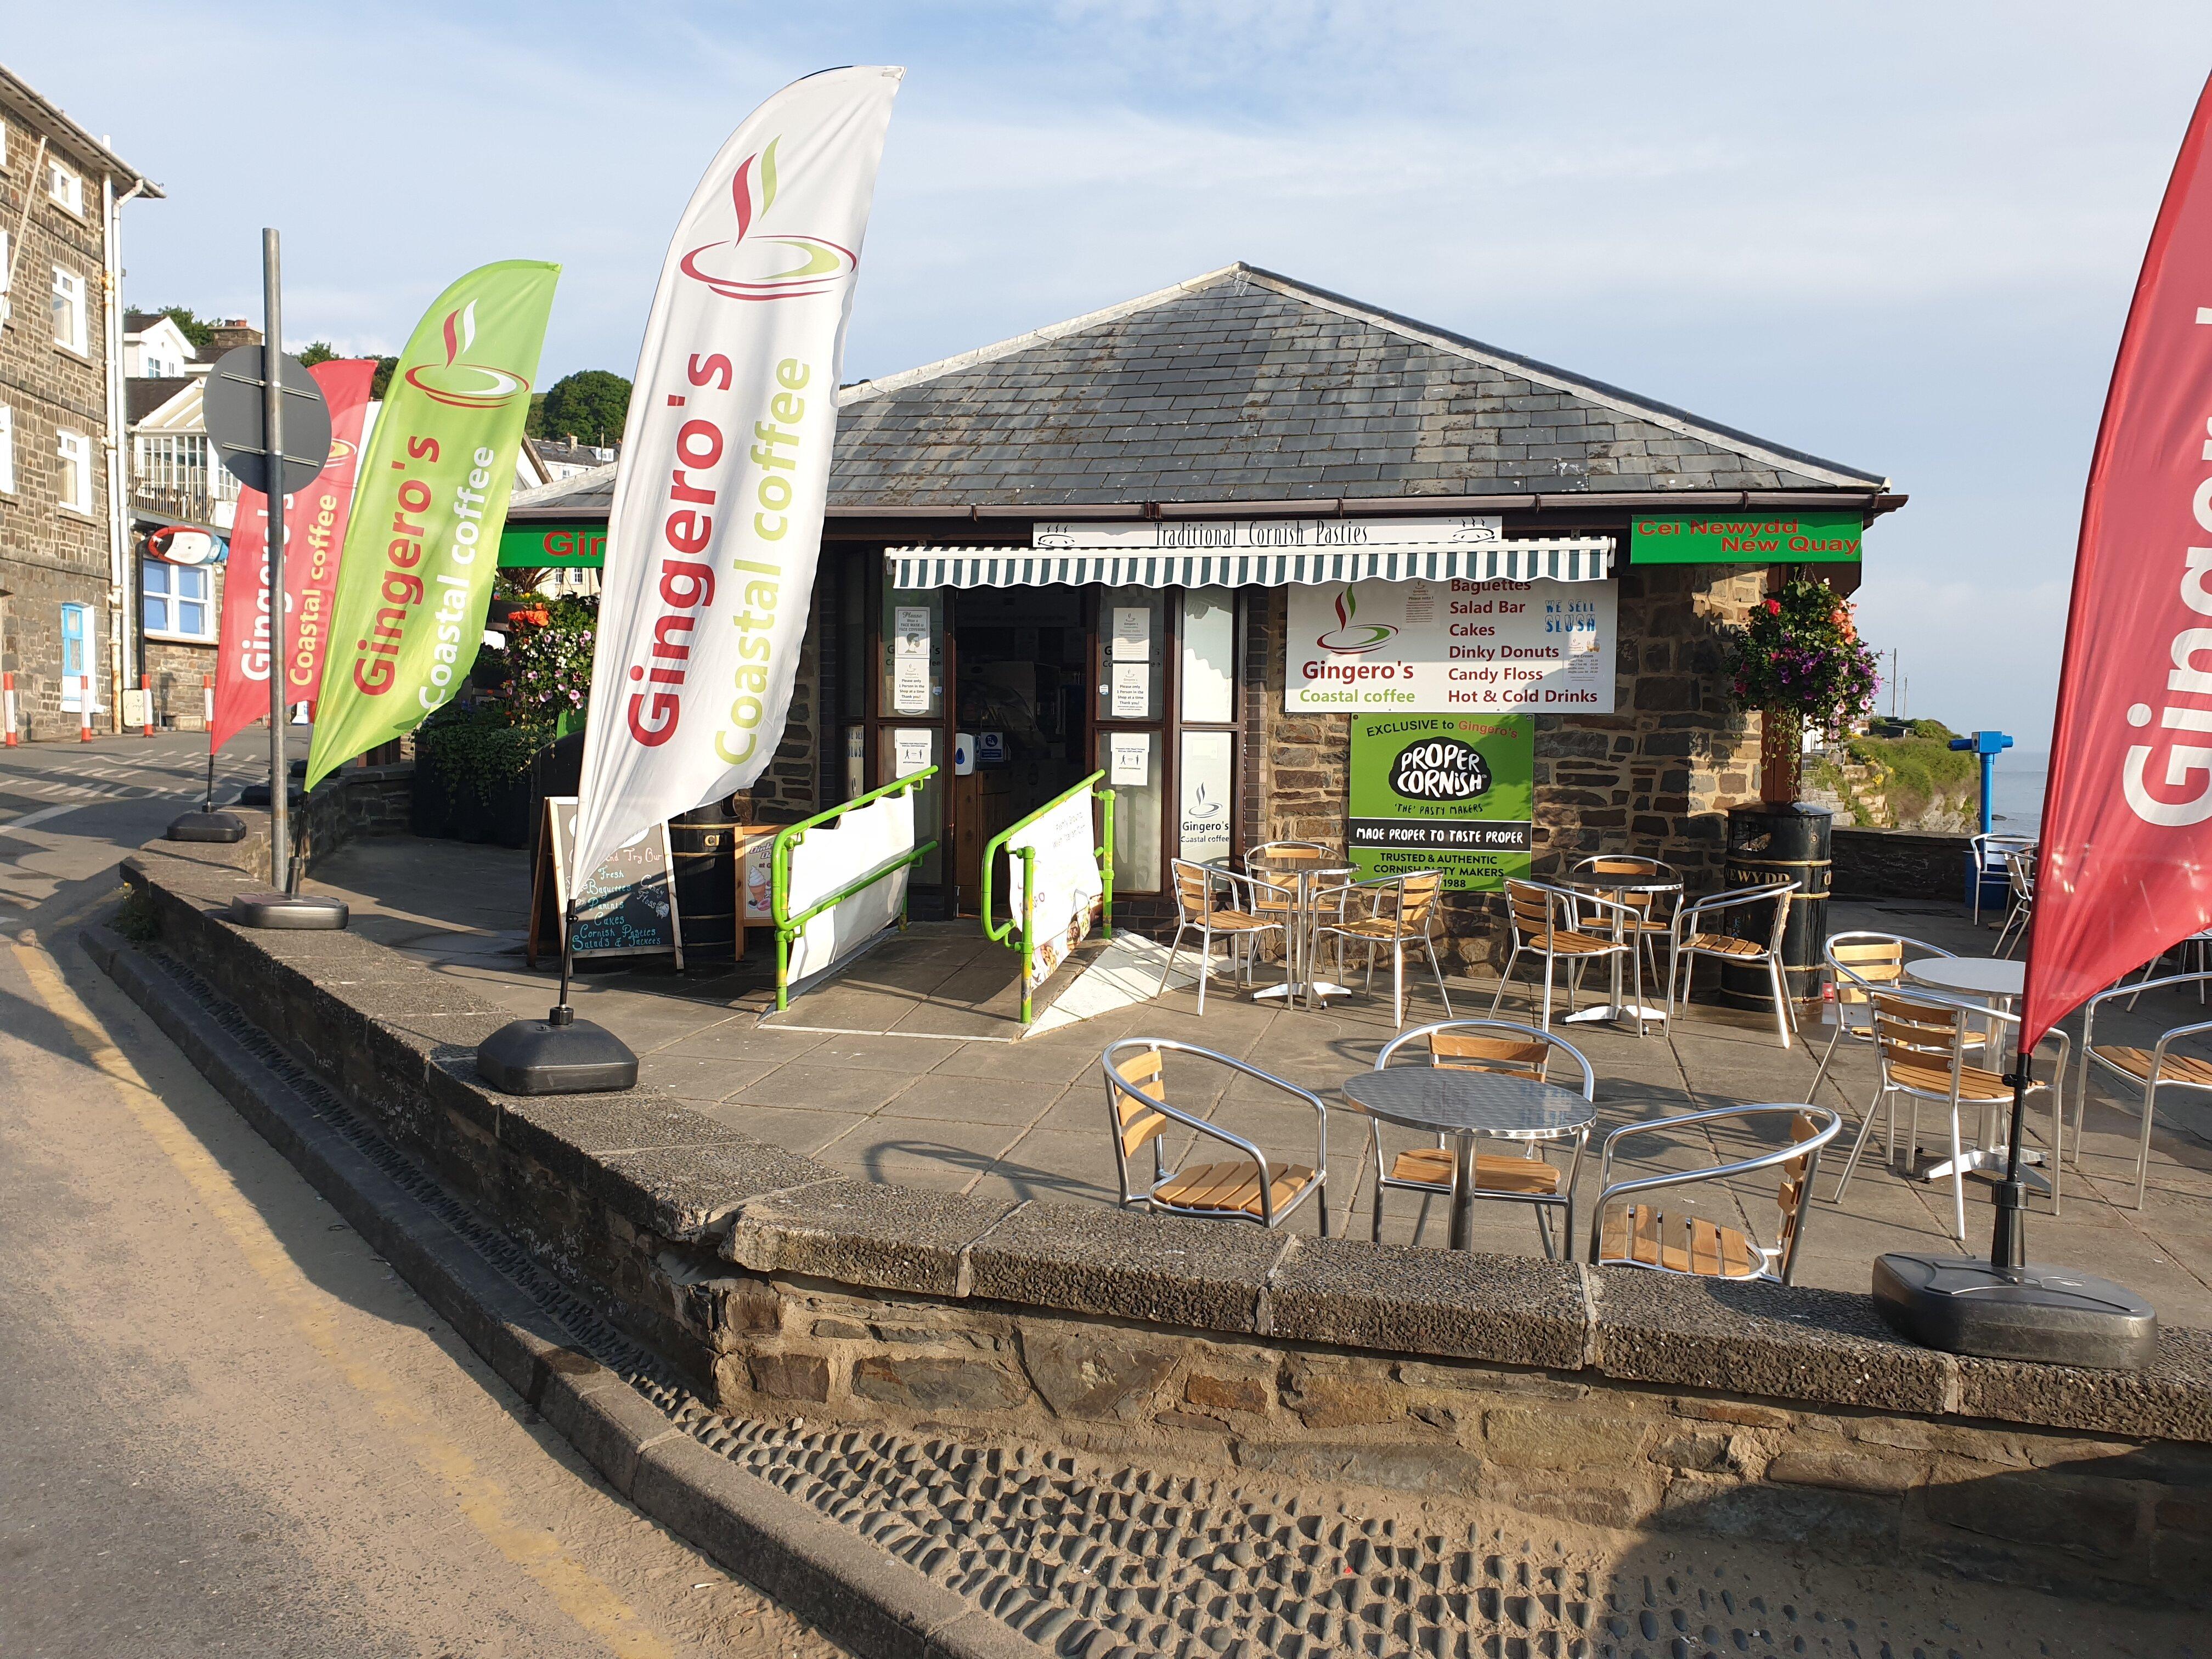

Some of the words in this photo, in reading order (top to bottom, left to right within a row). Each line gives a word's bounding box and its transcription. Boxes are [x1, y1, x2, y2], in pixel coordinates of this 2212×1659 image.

[1154, 521, 1237, 546] Traditional
[1249, 521, 1304, 545] Cornish
[1316, 520, 1367, 544] Pasties
[1638, 520, 1680, 535] Cei
[1690, 518, 1798, 538] Newydd
[627, 353, 732, 747] Gingero's
[1721, 537, 1780, 552] New
[1787, 536, 1860, 555] Quay
[353, 435, 440, 696] Gingero's
[715, 558, 781, 765] Coastal
[751, 358, 810, 542] coffee
[419, 574, 470, 710] Coastal
[452, 446, 494, 565] coffee
[290, 589, 321, 686] Coastal
[307, 494, 337, 580] coffee
[1451, 579, 1532, 595] Baguettes
[1450, 600, 1493, 614] Salad
[1499, 601, 1526, 613] Bar
[1545, 600, 1562, 613] WE
[1568, 599, 1595, 612] SELL
[1449, 623, 1496, 636] Cakes
[1545, 614, 1595, 633] SLUSH
[1449, 645, 1496, 662] Dinky
[1501, 646, 1559, 658] Donuts
[1302, 661, 1414, 685] Gingero's
[1448, 667, 1498, 684] Candy
[1504, 667, 1543, 680] Floss
[1300, 689, 1358, 702] Coastal
[1364, 689, 1415, 702] coffee
[1448, 690, 1478, 703] Hot
[1483, 690, 1497, 703] &
[1503, 689, 1539, 703] Cold
[1545, 689, 1598, 703] Drinks
[1366, 720, 1438, 737] EXCLUSIVE
[1442, 720, 1454, 730] to
[1458, 720, 1519, 740] Gingero's
[1401, 743, 1480, 773] PROPER
[1419, 805, 1445, 816] PASTY
[1449, 803, 1483, 815] MAKERS
[1182, 821, 1229, 833] Gingero's
[1356, 827, 1384, 840] MADE
[1389, 828, 1425, 841] PROPER
[1430, 829, 1444, 842] TO
[1449, 830, 1481, 843] TASTE
[1486, 831, 1523, 844] PROPER
[623, 848, 642, 864] Try
[645, 847, 662, 862] Our
[1380, 853, 1426, 862] TRUSTED
[1427, 854, 1435, 862] &
[1437, 854, 1498, 864] AUTHENTIC
[598, 865, 624, 880] Fresh
[1373, 864, 1421, 873] CORNISH
[1459, 867, 1504, 877] MAKERS
[587, 878, 631, 898] Baguettes
[640, 874, 664, 899] Candy
[1443, 879, 1466, 888] 1988
[587, 896, 624, 911] Paninis
[637, 890, 657, 909] Floss
[594, 912, 624, 926] Cakes
[580, 924, 616, 939] Cornish
